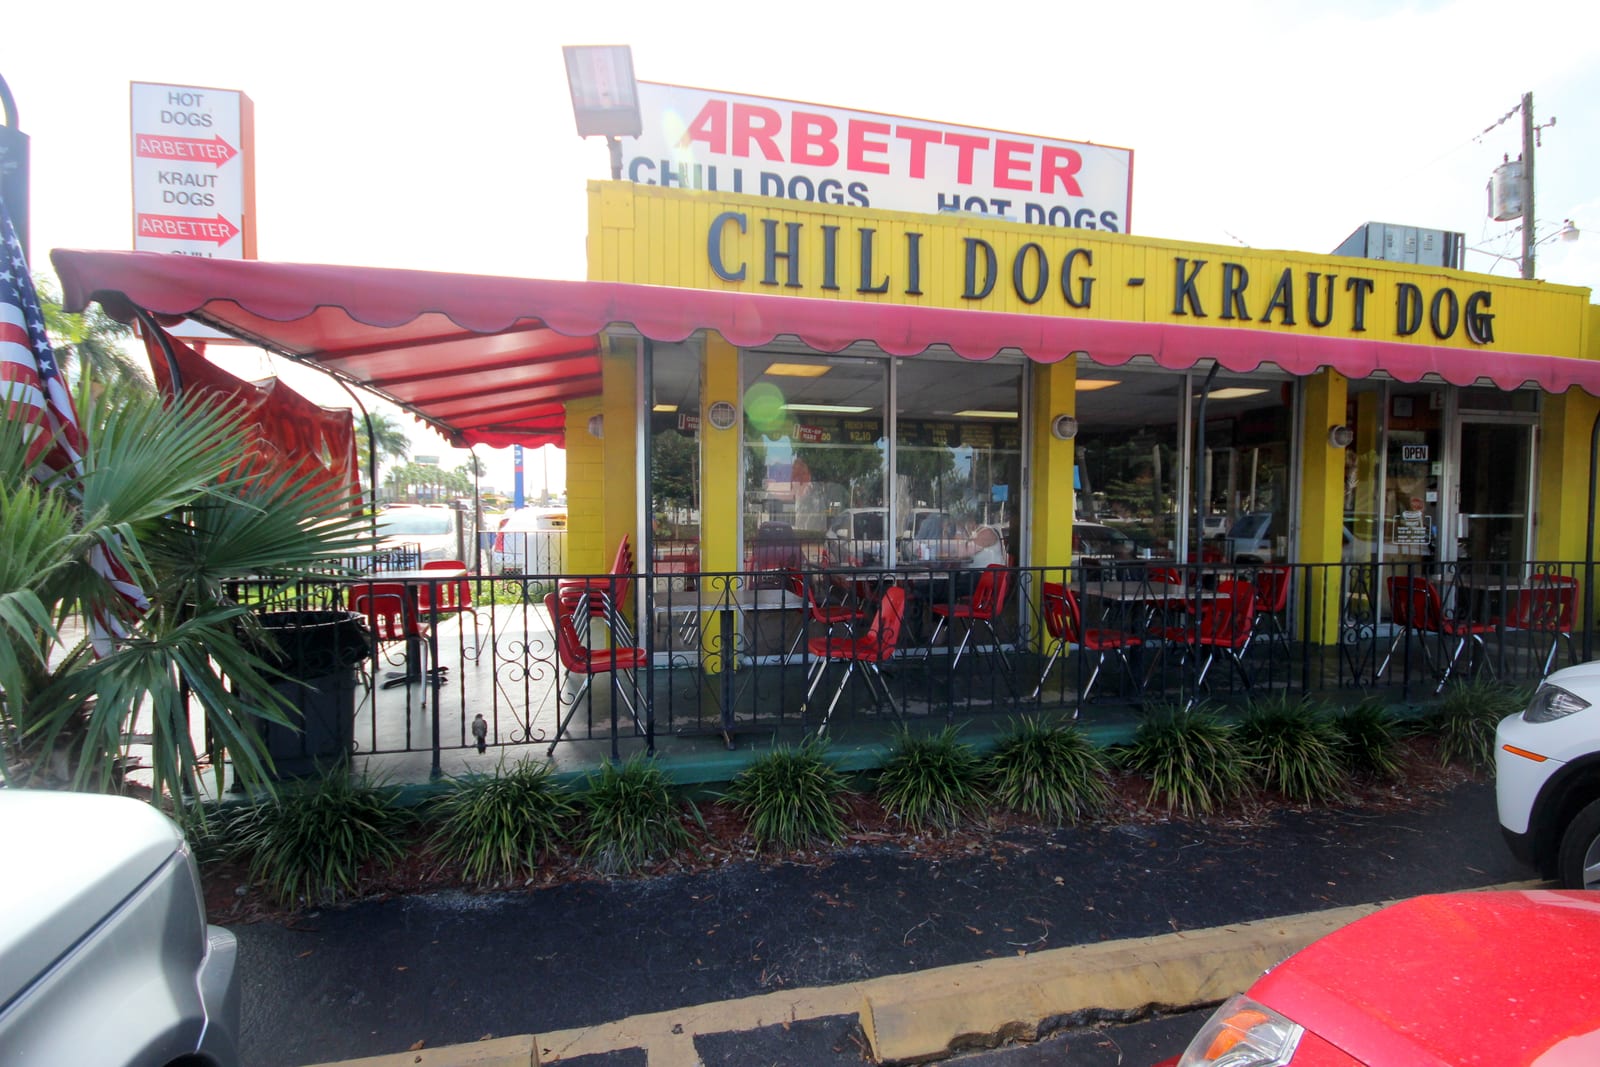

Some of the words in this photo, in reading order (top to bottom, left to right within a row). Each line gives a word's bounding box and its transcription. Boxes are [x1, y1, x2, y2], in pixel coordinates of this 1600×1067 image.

[168, 91, 204, 108] HOT
[160, 110, 213, 128] DOGS
[139, 139, 229, 159] ARBETTER
[677, 98, 1084, 197] ARBETTER
[158, 170, 218, 188] KRAUT
[163, 190, 215, 207] DOGS
[760, 171, 870, 208] DOGS
[1025, 202, 1119, 233] DOGS
[141, 218, 231, 238] ARBETTER
[707, 211, 923, 296] CHILI
[961, 237, 1097, 309] DOG
[1172, 257, 1374, 332] KRAUT
[1395, 282, 1495, 345] DOG
[1404, 447, 1426, 460] OPEN
